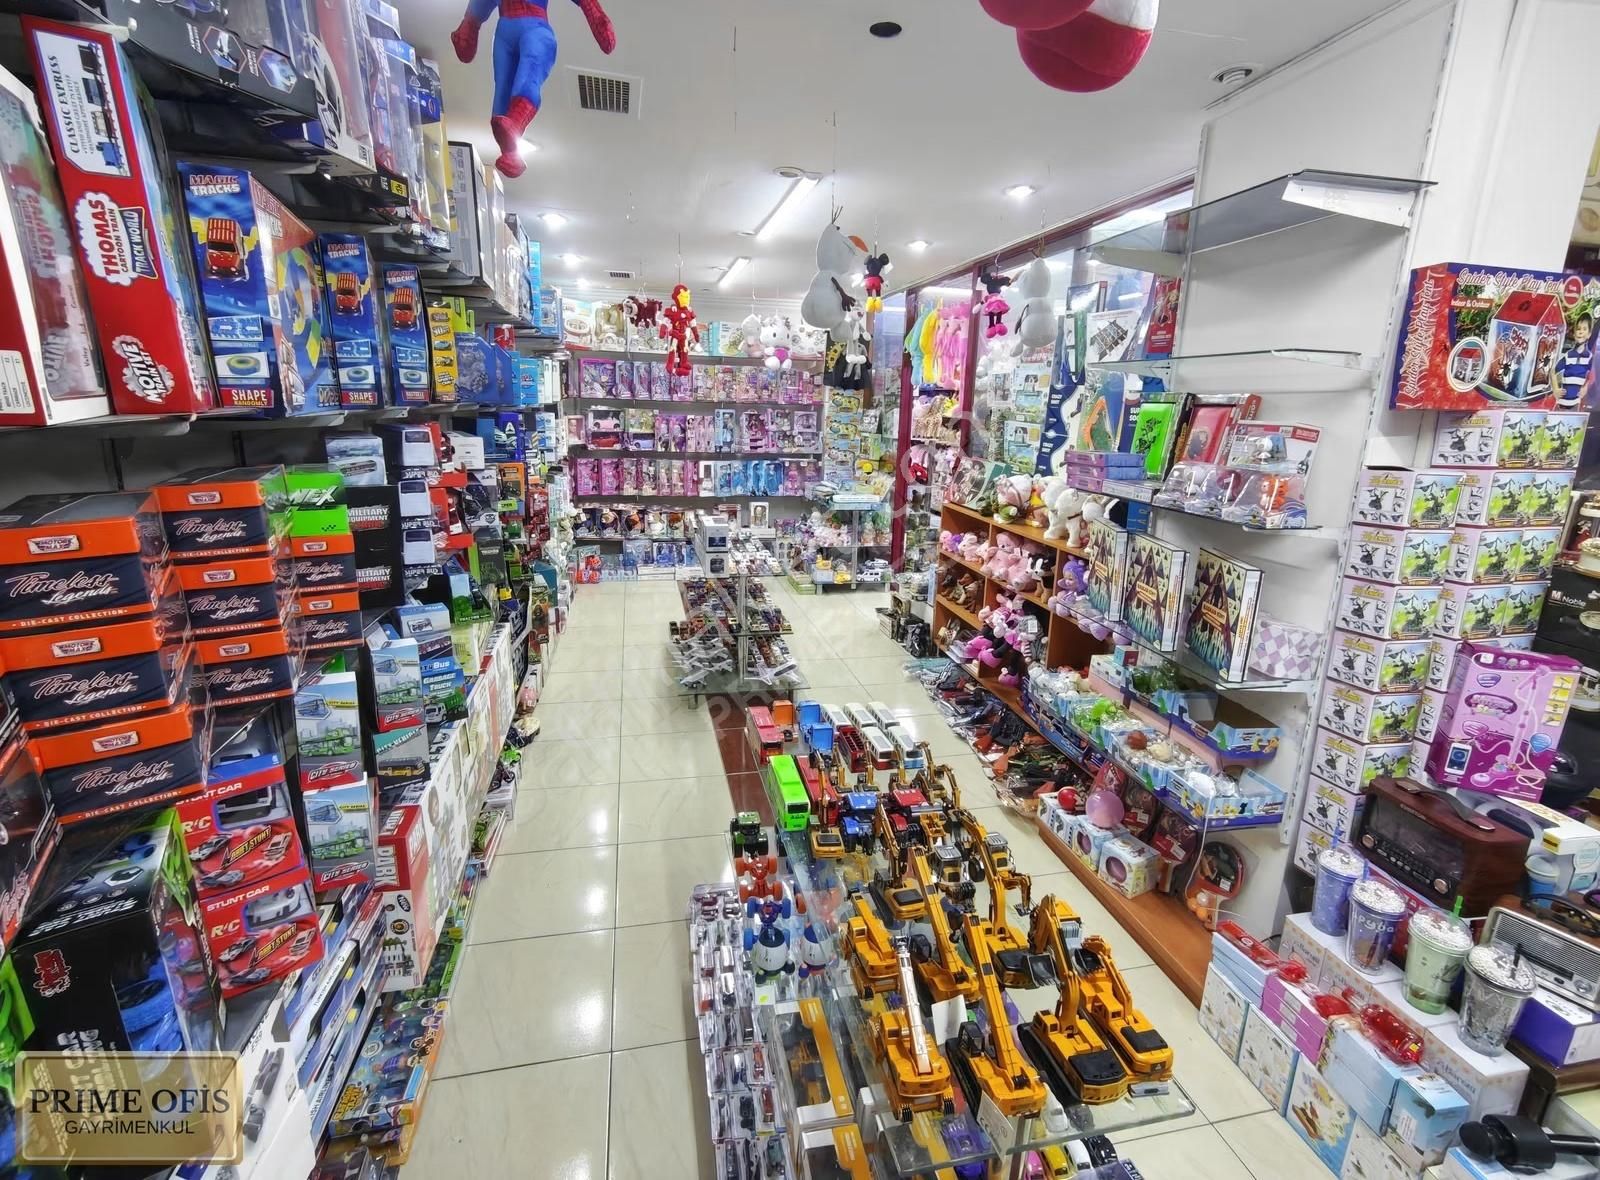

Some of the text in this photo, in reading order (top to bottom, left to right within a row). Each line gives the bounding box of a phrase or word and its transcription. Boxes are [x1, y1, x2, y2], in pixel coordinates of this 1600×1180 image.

[48, 55, 69, 105] EXPRESS
[61, 107, 80, 153] CLASSIC
[190, 184, 241, 196] TRACKS
[88, 198, 121, 277] THOMAS
[109, 207, 130, 273] CARTOON TRAIN
[126, 210, 148, 276] TRACK WORLD
[328, 250, 360, 259] TRACKS
[386, 276, 415, 284] TRACKS
[1457, 268, 1492, 288] Spider
[1493, 271, 1520, 293] Style
[1519, 273, 1543, 292] Play
[1450, 299, 1467, 307] Indoor
[1404, 278, 1435, 398] Spider Style Play Tent
[121, 342, 162, 402] MOTIVE
[231, 389, 268, 401] SHAPE
[173, 517, 247, 537] Timeless
[348, 514, 389, 522] QUIPMENT
[196, 529, 246, 544] Legends
[5, 571, 119, 599] Timeless
[41, 586, 118, 606] Legends
[188, 595, 261, 615] Timeless
[1562, 596, 1587, 607] Noble
[20, 609, 124, 628] DIE-CAST COLLECTION
[209, 607, 260, 620] Legends
[30, 670, 140, 700] Timeless
[204, 667, 274, 687] Timeless
[225, 677, 273, 693] Legends
[423, 673, 457, 685] GARBAGE
[429, 681, 453, 691] TRUCK
[64, 684, 137, 705] Legends
[43, 704, 144, 727] DIE-CAST COLLECTION
[386, 708, 422, 722] CITY SERIES
[72, 761, 174, 792] Timeless
[309, 761, 358, 780] CITY SERIES
[105, 772, 173, 796] Legends
[218, 782, 243, 796] CAR
[85, 790, 178, 819] DIE-CAST COLLECTION
[323, 862, 370, 881] CITY SERIES
[206, 885, 270, 913] STUNT CAR
